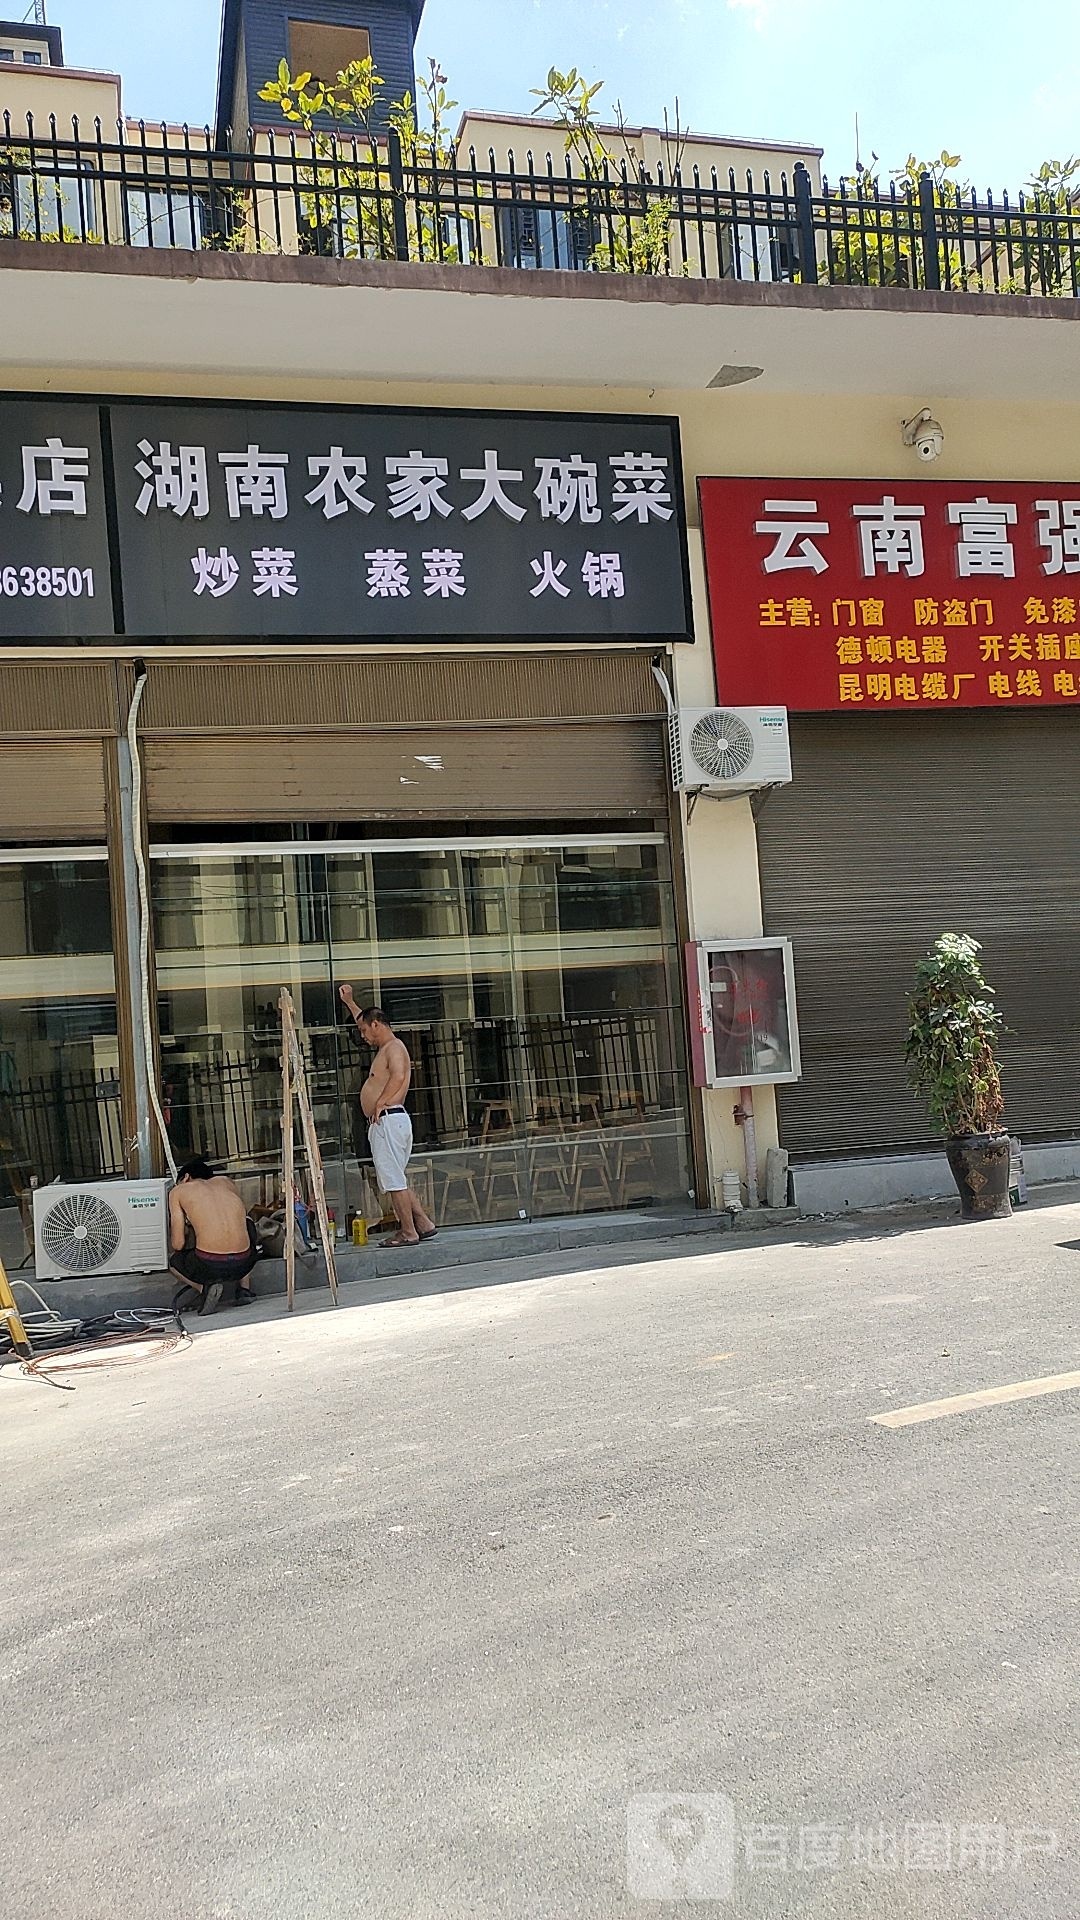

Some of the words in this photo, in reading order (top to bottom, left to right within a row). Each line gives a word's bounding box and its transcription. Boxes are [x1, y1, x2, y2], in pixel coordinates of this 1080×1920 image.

[0, 437, 89, 515] 店
[133, 437, 674, 524] 湖南农家大碗菜
[754, 496, 1080, 578] 云南富强
[0, 566, 95, 597] 638501
[190, 546, 300, 598] 炒菜
[364, 549, 467, 598] 蒸菜
[529, 551, 625, 599] 火锅
[914, 597, 994, 626] 防盗门
[1023, 596, 1080, 625] 免漆
[835, 635, 948, 664] 德顿电器
[838, 672, 976, 701] 昆明电缆厂
[1053, 669, 1080, 697] 电
[127, 1196, 160, 1204] Hisense
